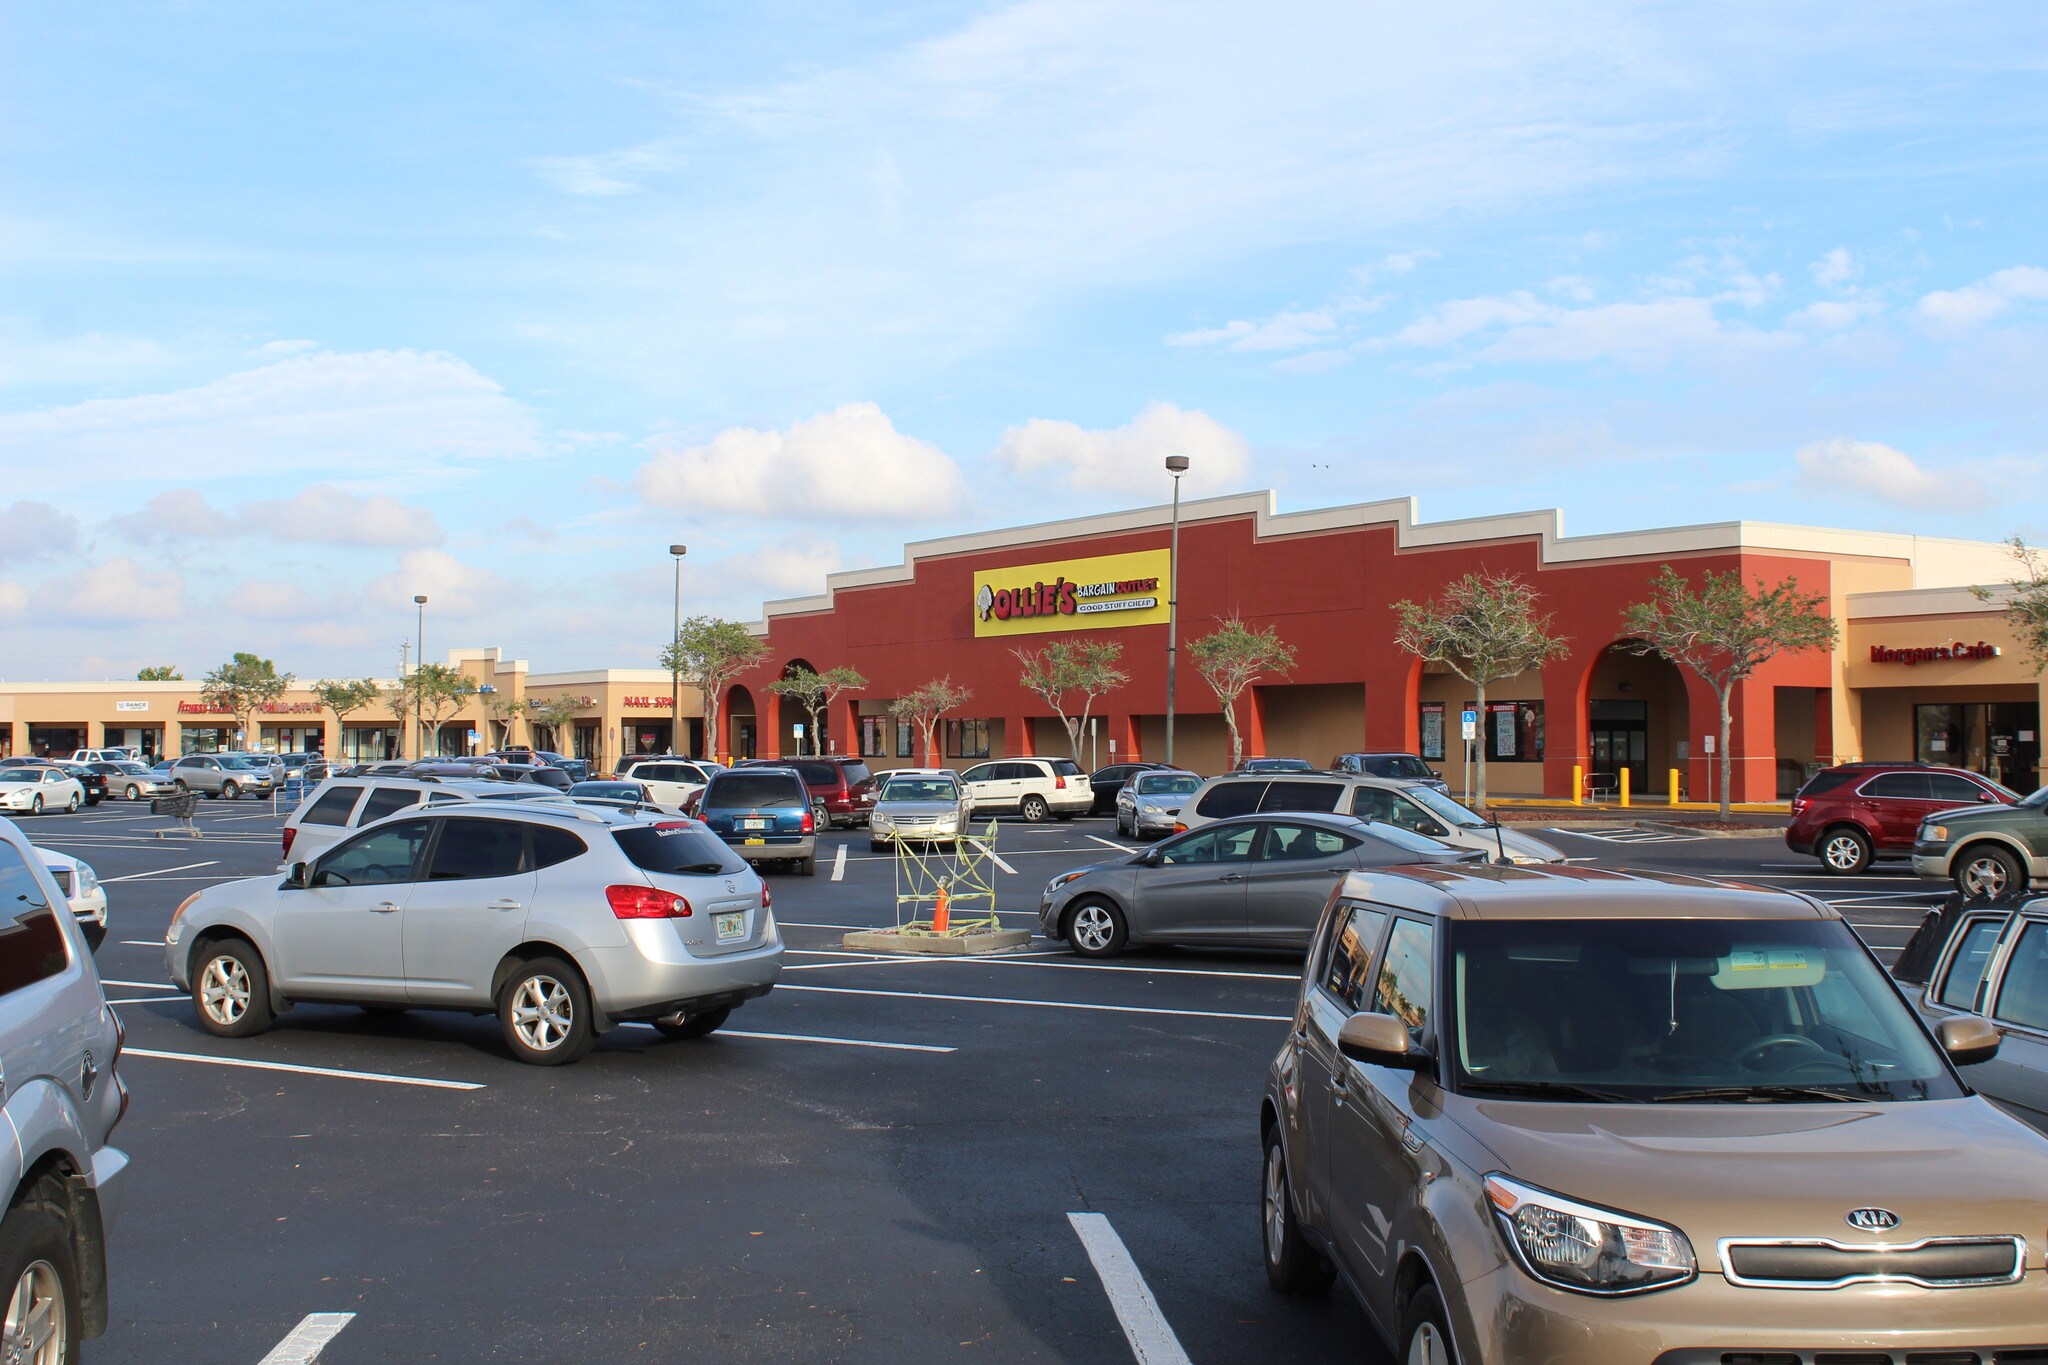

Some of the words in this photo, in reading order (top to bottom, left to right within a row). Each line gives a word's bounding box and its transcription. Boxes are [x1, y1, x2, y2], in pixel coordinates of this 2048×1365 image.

[1077, 582, 1115, 598] BARGAIN
[1115, 578, 1158, 593] OUTLET
[1871, 645, 1950, 665] Morgan's
[1952, 641, 1995, 660] Cafe
[623, 696, 650, 706] NAIL
[654, 696, 674, 707] SPA
[1853, 1210, 1894, 1226] KIA
